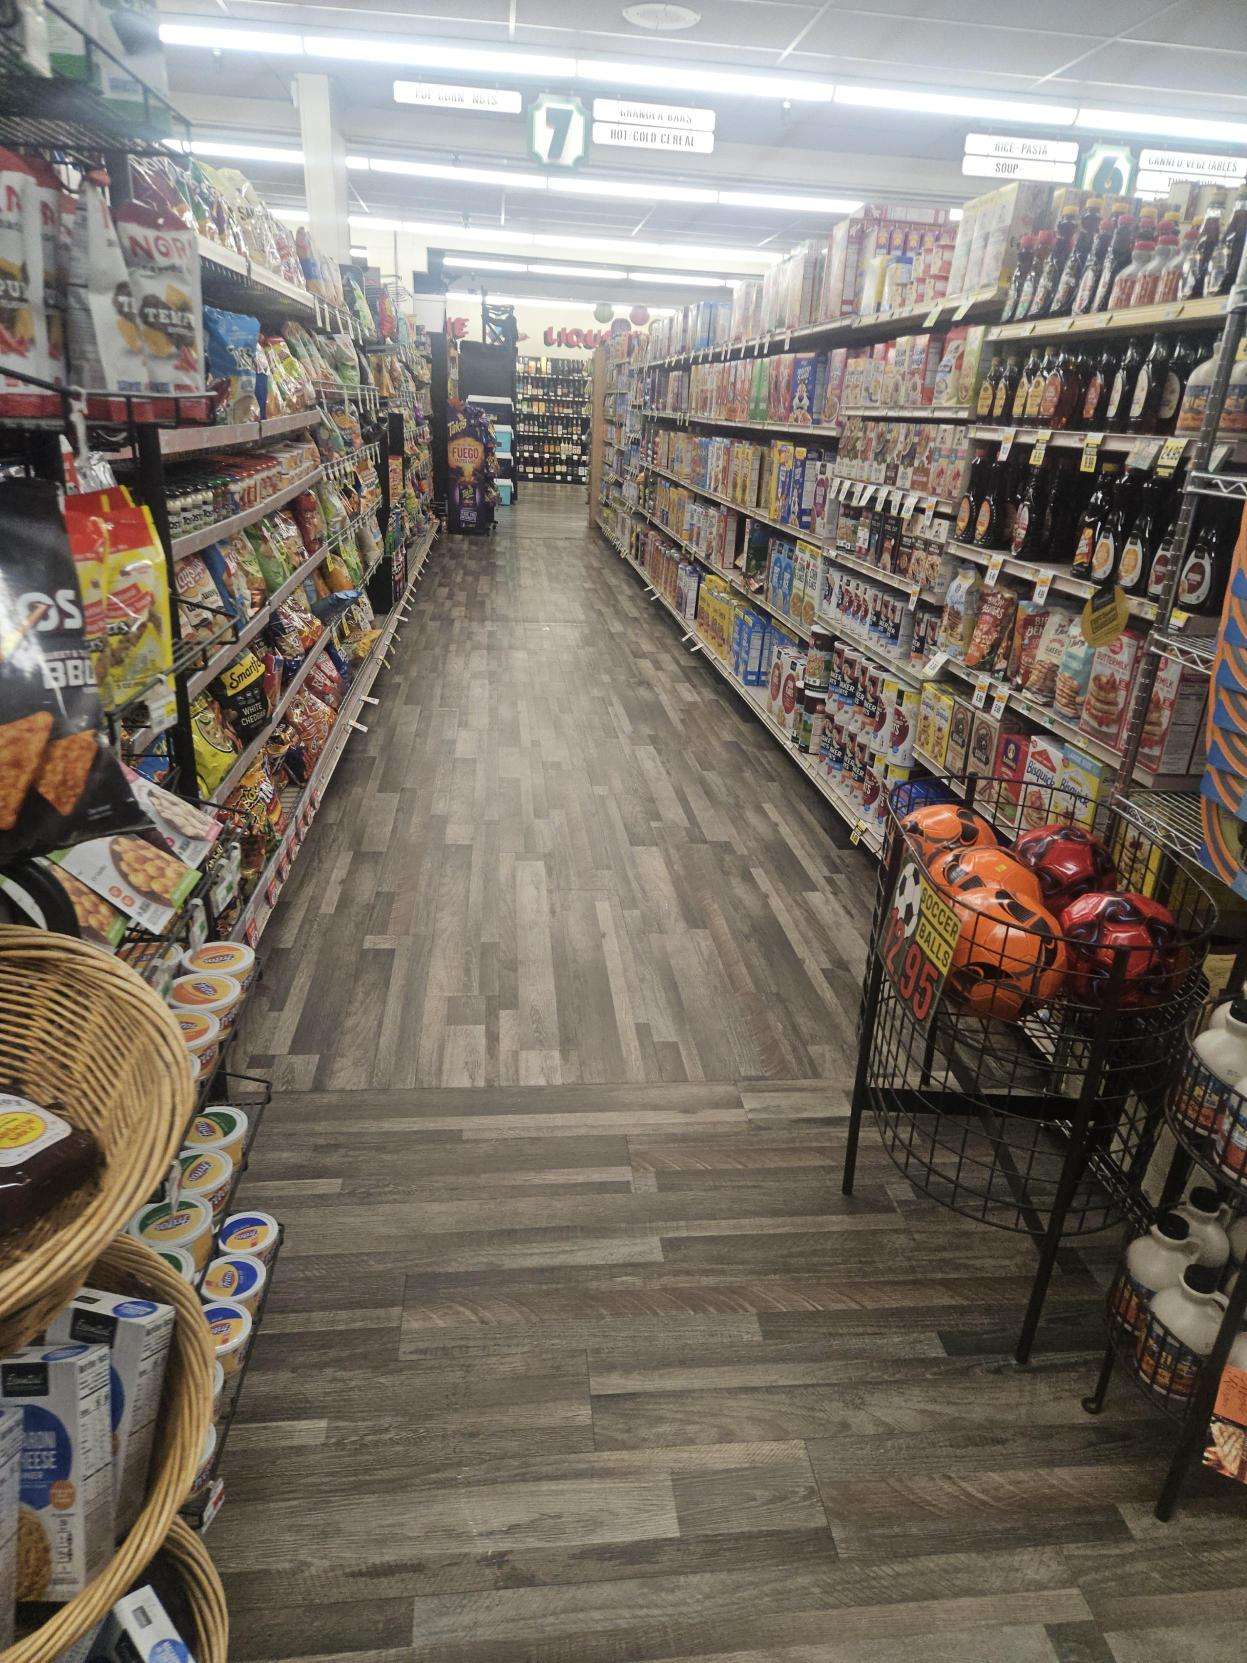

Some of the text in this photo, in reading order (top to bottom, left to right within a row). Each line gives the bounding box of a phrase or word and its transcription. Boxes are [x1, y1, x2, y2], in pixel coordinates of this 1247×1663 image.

[545, 106, 574, 161] 7
[610, 128, 695, 147] HOT COLD CEREAL
[993, 142, 1014, 153] RICE
[1021, 143, 1048, 155] PASTA
[994, 161, 1019, 174] SOUP
[1092, 155, 1124, 197] 6
[1186, 160, 1238, 173] VEGETABLES
[452, 446, 479, 459] FUEGO
[242, 703, 263, 716] WHITE
[1026, 760, 1056, 787] Bisquick
[920, 887, 959, 942] SOCCER
[919, 922, 950, 967] BALLS
